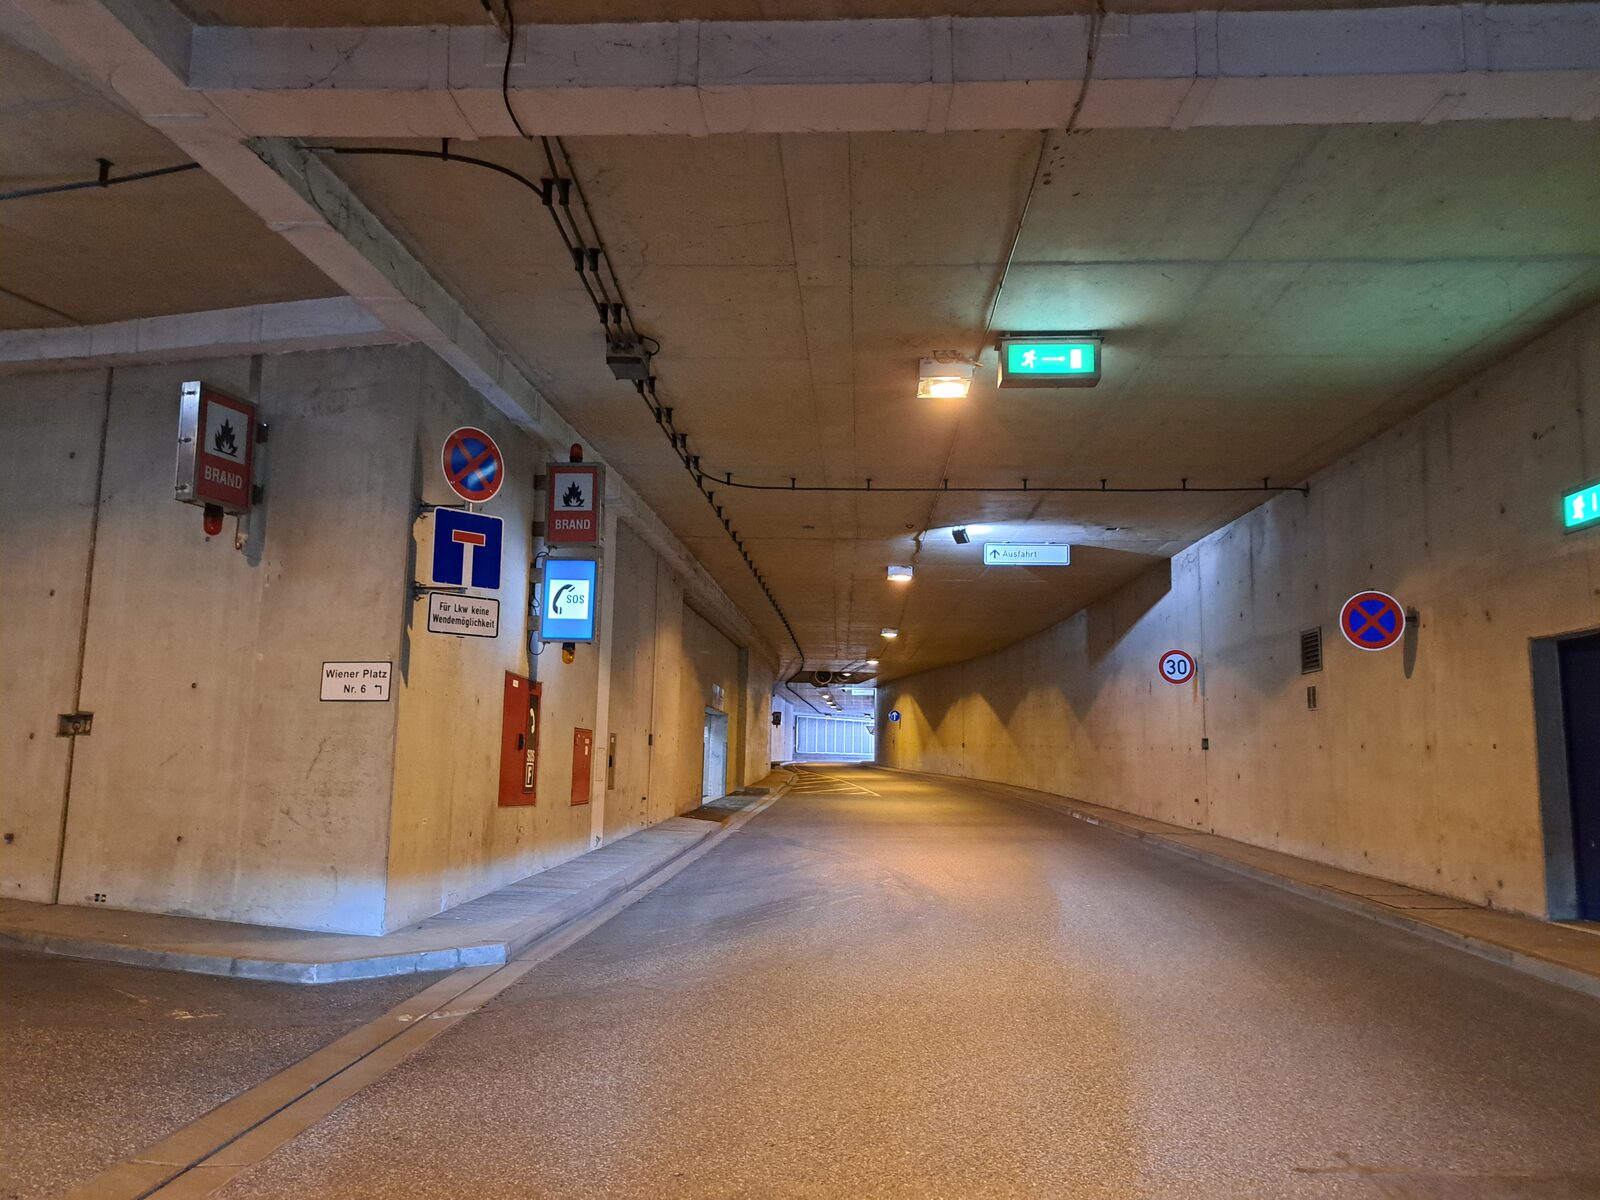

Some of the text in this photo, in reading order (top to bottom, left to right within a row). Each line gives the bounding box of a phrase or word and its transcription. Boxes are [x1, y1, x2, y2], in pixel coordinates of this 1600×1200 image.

[204, 465, 243, 489] BRAND
[555, 518, 592, 530] BRAND
[1002, 549, 1038, 559] Ausfahrt
[566, 594, 585, 604] SOS
[439, 601, 490, 616] Für Lkw keine
[432, 613, 495, 629] Wendemöglichkeit
[1166, 659, 1188, 675] 30
[325, 669, 388, 679] Wiener Platz
[343, 684, 367, 694] Nr. 6
